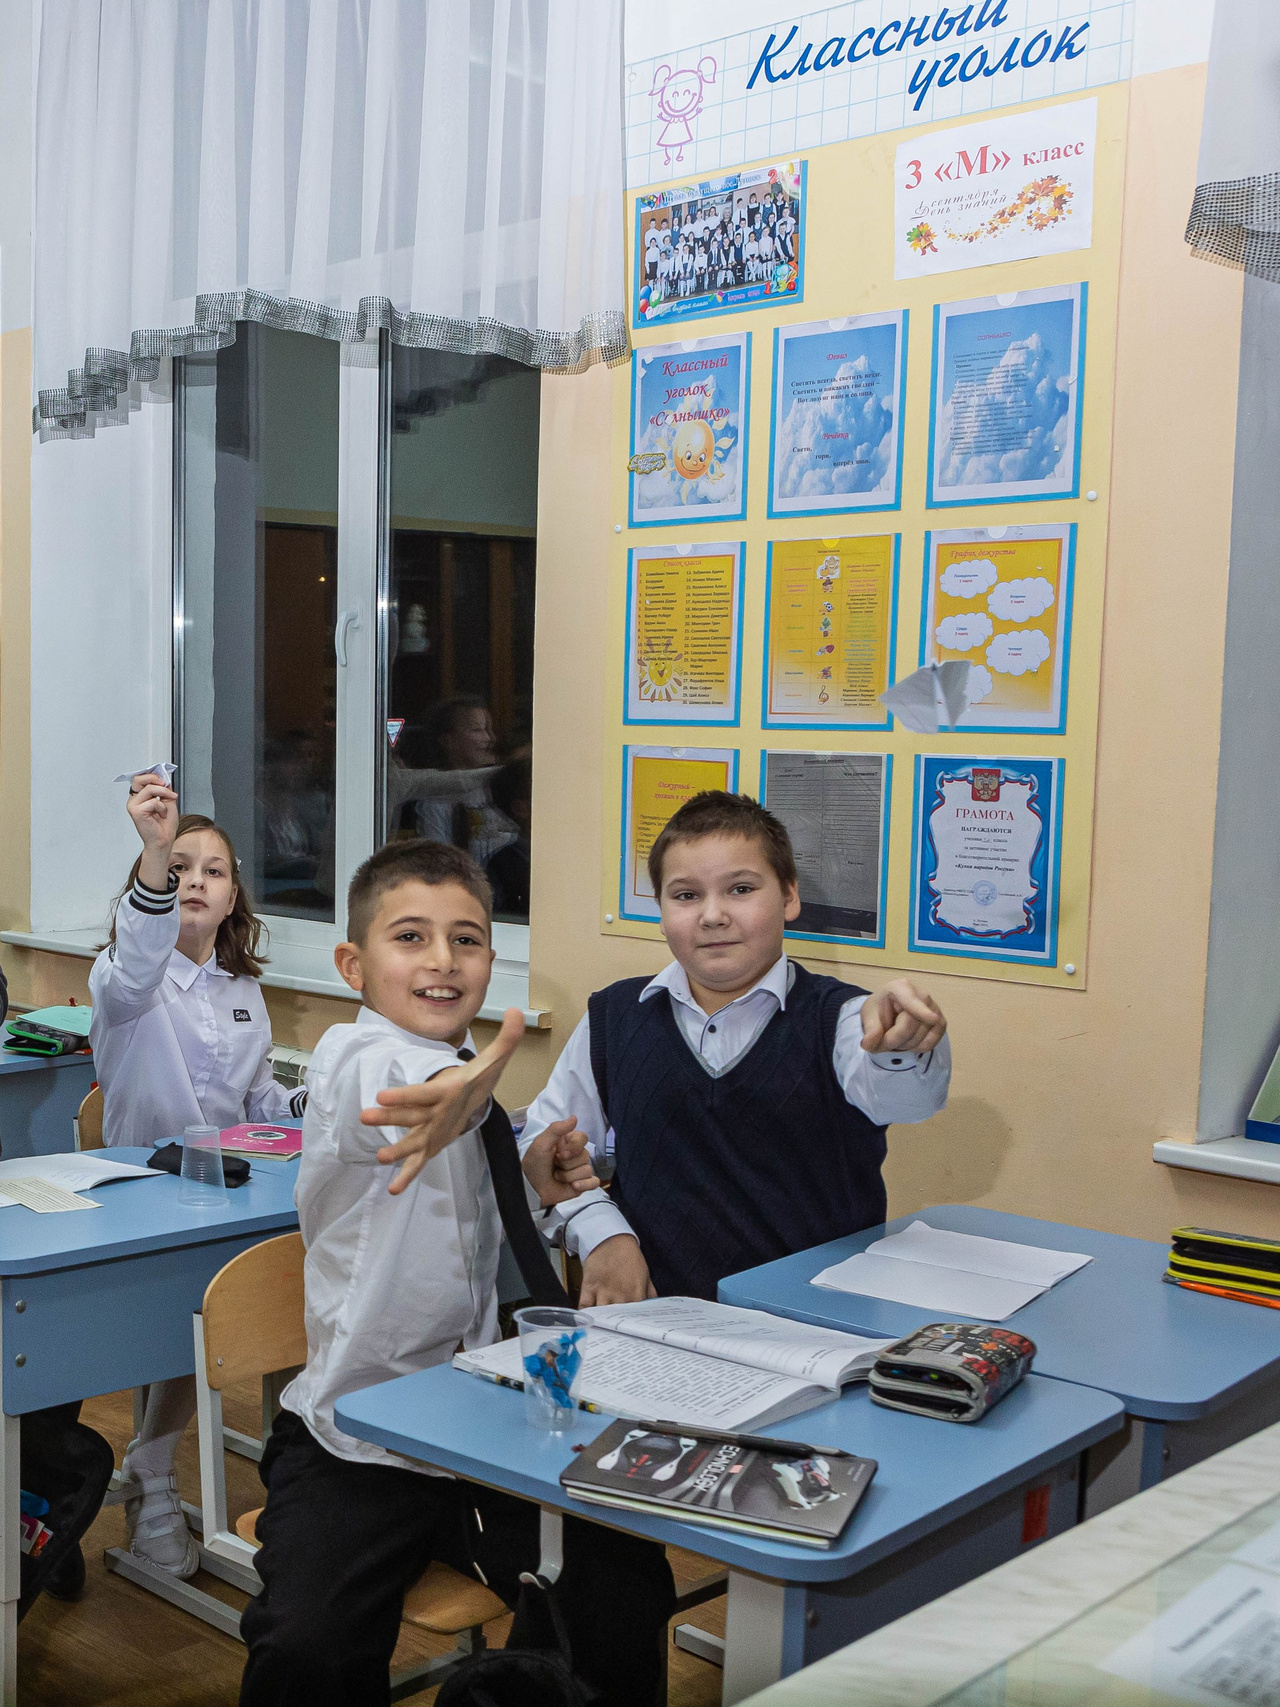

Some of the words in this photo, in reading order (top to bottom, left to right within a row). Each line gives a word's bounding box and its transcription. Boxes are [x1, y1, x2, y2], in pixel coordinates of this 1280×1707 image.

[746, 0, 1008, 90] Классный
[907, 22, 1090, 111] уголок
[905, 159, 922, 190] 3
[934, 144, 1011, 182] «М»
[1023, 142, 1084, 166] класс
[910, 204, 952, 220] День
[958, 195, 1008, 211] знаний
[931, 188, 999, 208] сентября
[662, 354, 728, 376] Классный
[663, 383, 710, 404] уголок
[950, 550, 976, 558] График
[978, 548, 1016, 558] дежурства
[956, 808, 1014, 820] ГРАМОТА
[236, 1011, 249, 1020] Style
